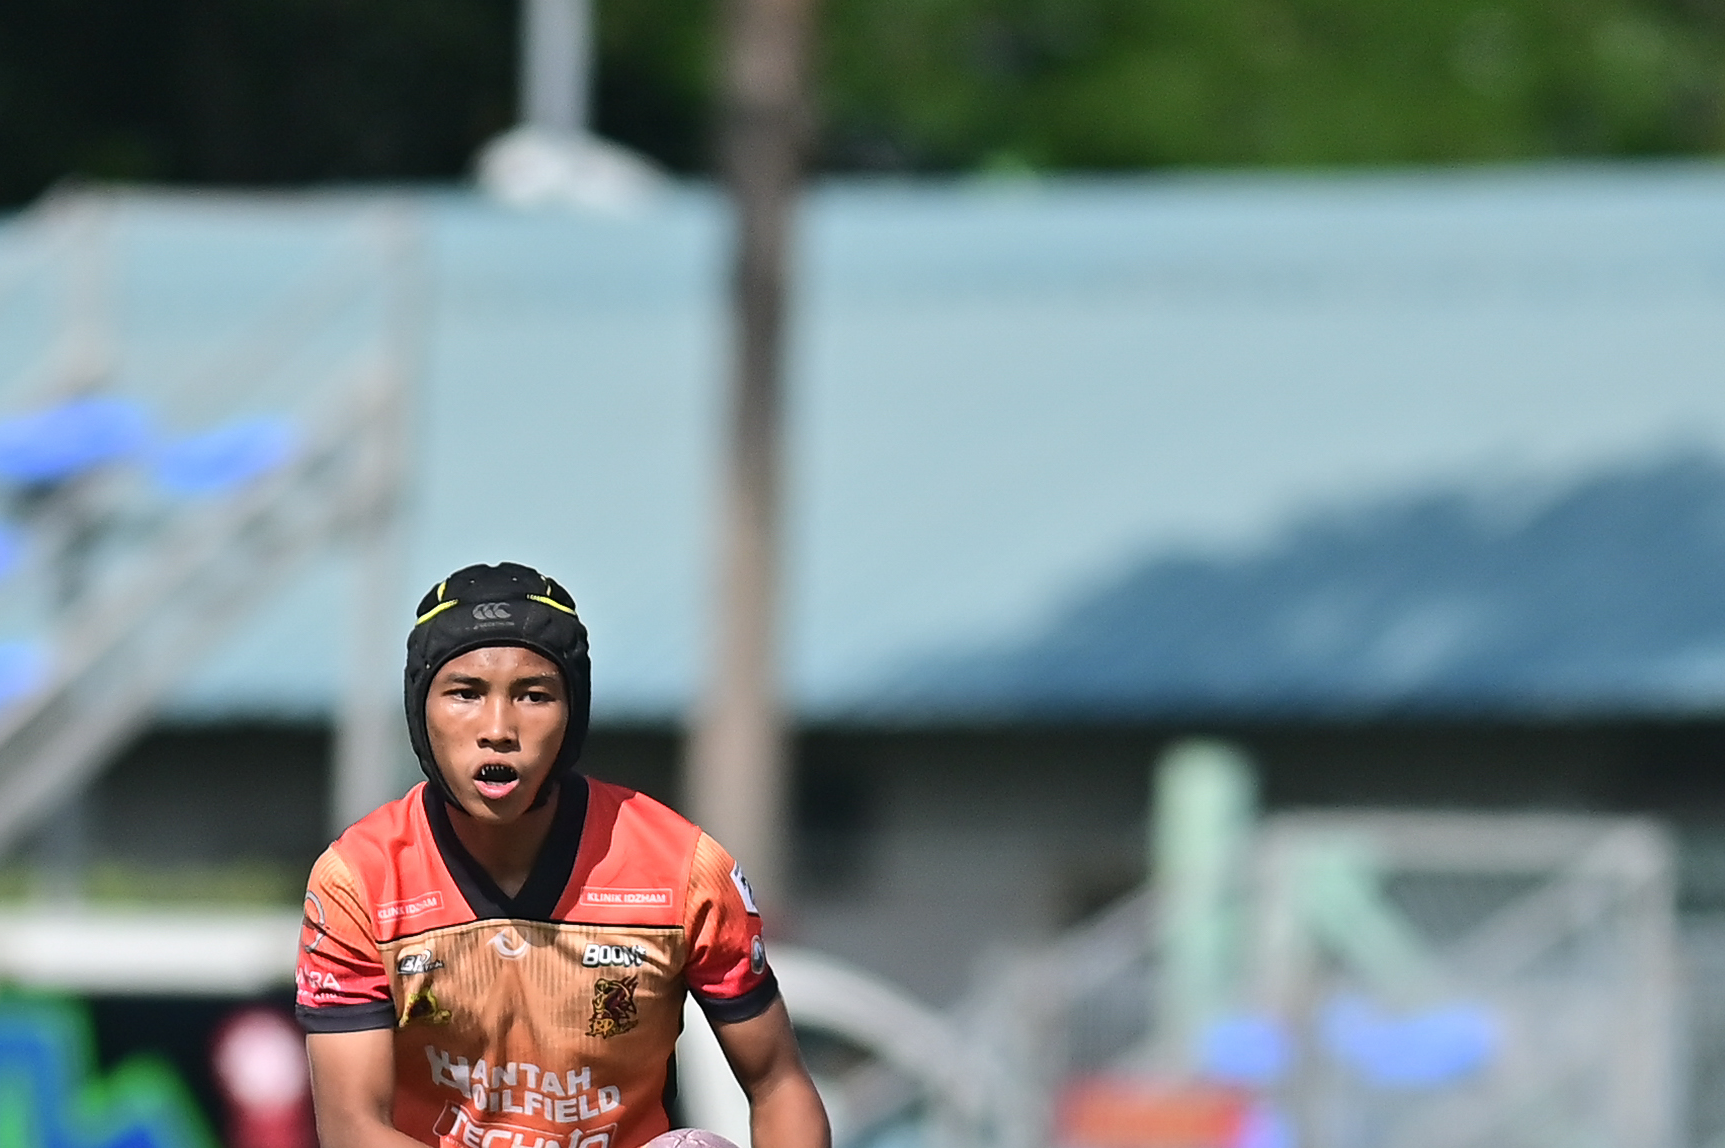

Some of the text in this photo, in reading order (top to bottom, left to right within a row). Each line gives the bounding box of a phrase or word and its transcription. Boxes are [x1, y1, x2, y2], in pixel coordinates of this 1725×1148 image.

[586, 892, 667, 904] KLINIK IDZHAM
[472, 1083, 622, 1123] OILFIELD
